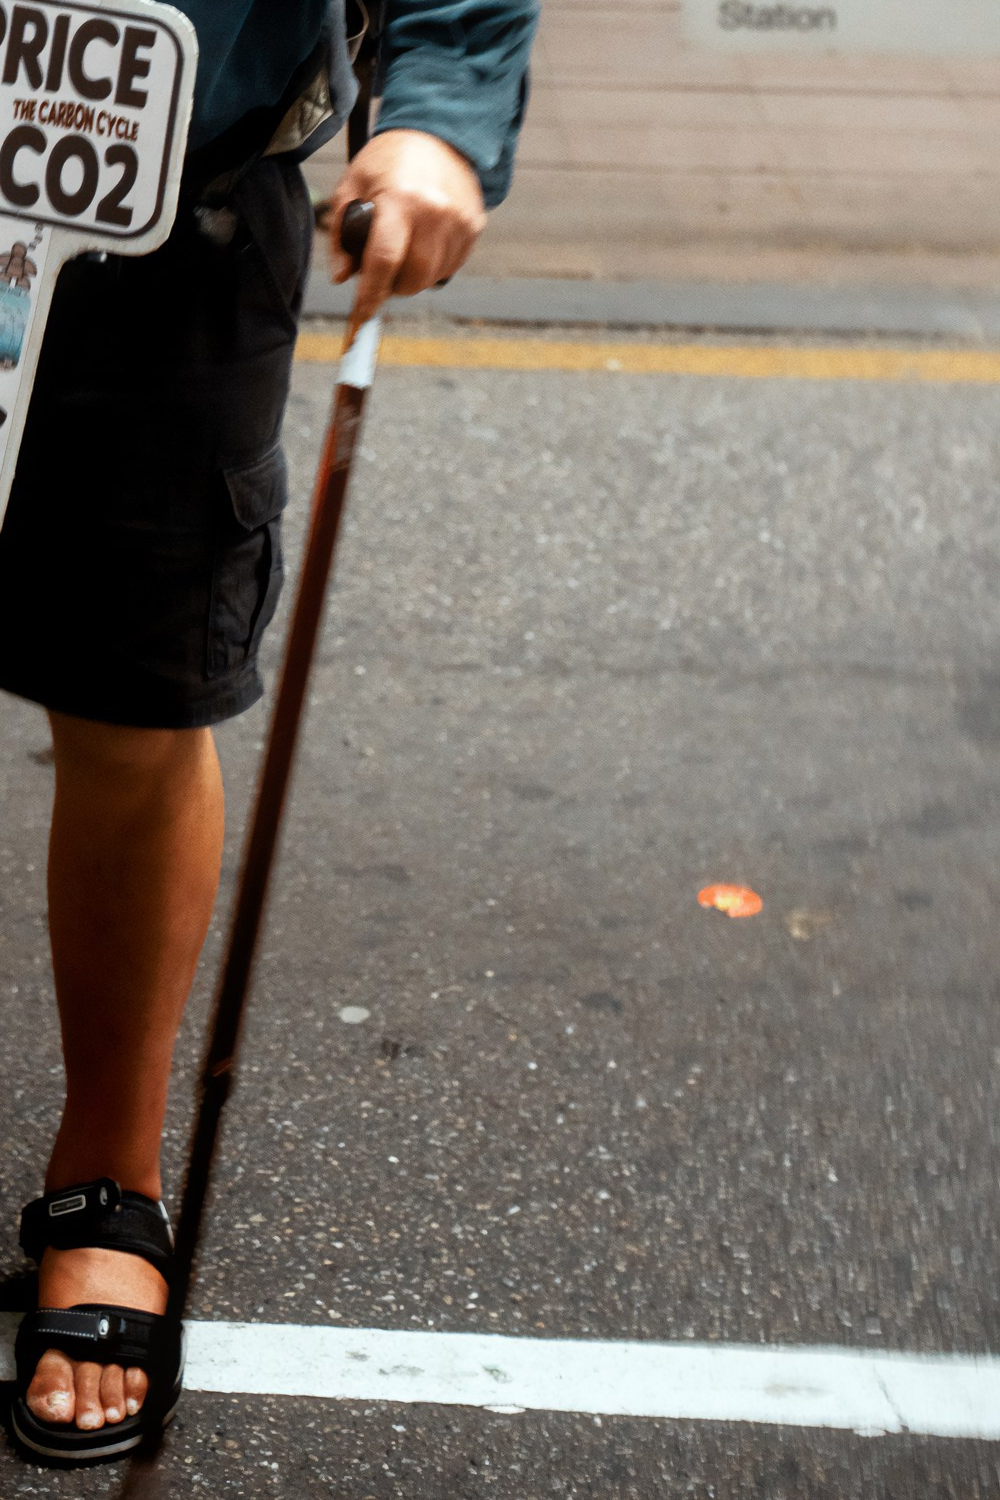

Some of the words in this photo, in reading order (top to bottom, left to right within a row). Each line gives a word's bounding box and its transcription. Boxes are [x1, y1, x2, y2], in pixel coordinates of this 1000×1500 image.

[13, 98, 38, 121] THE
[38, 99, 96, 134] CARBON
[96, 109, 140, 142] CYCLE
